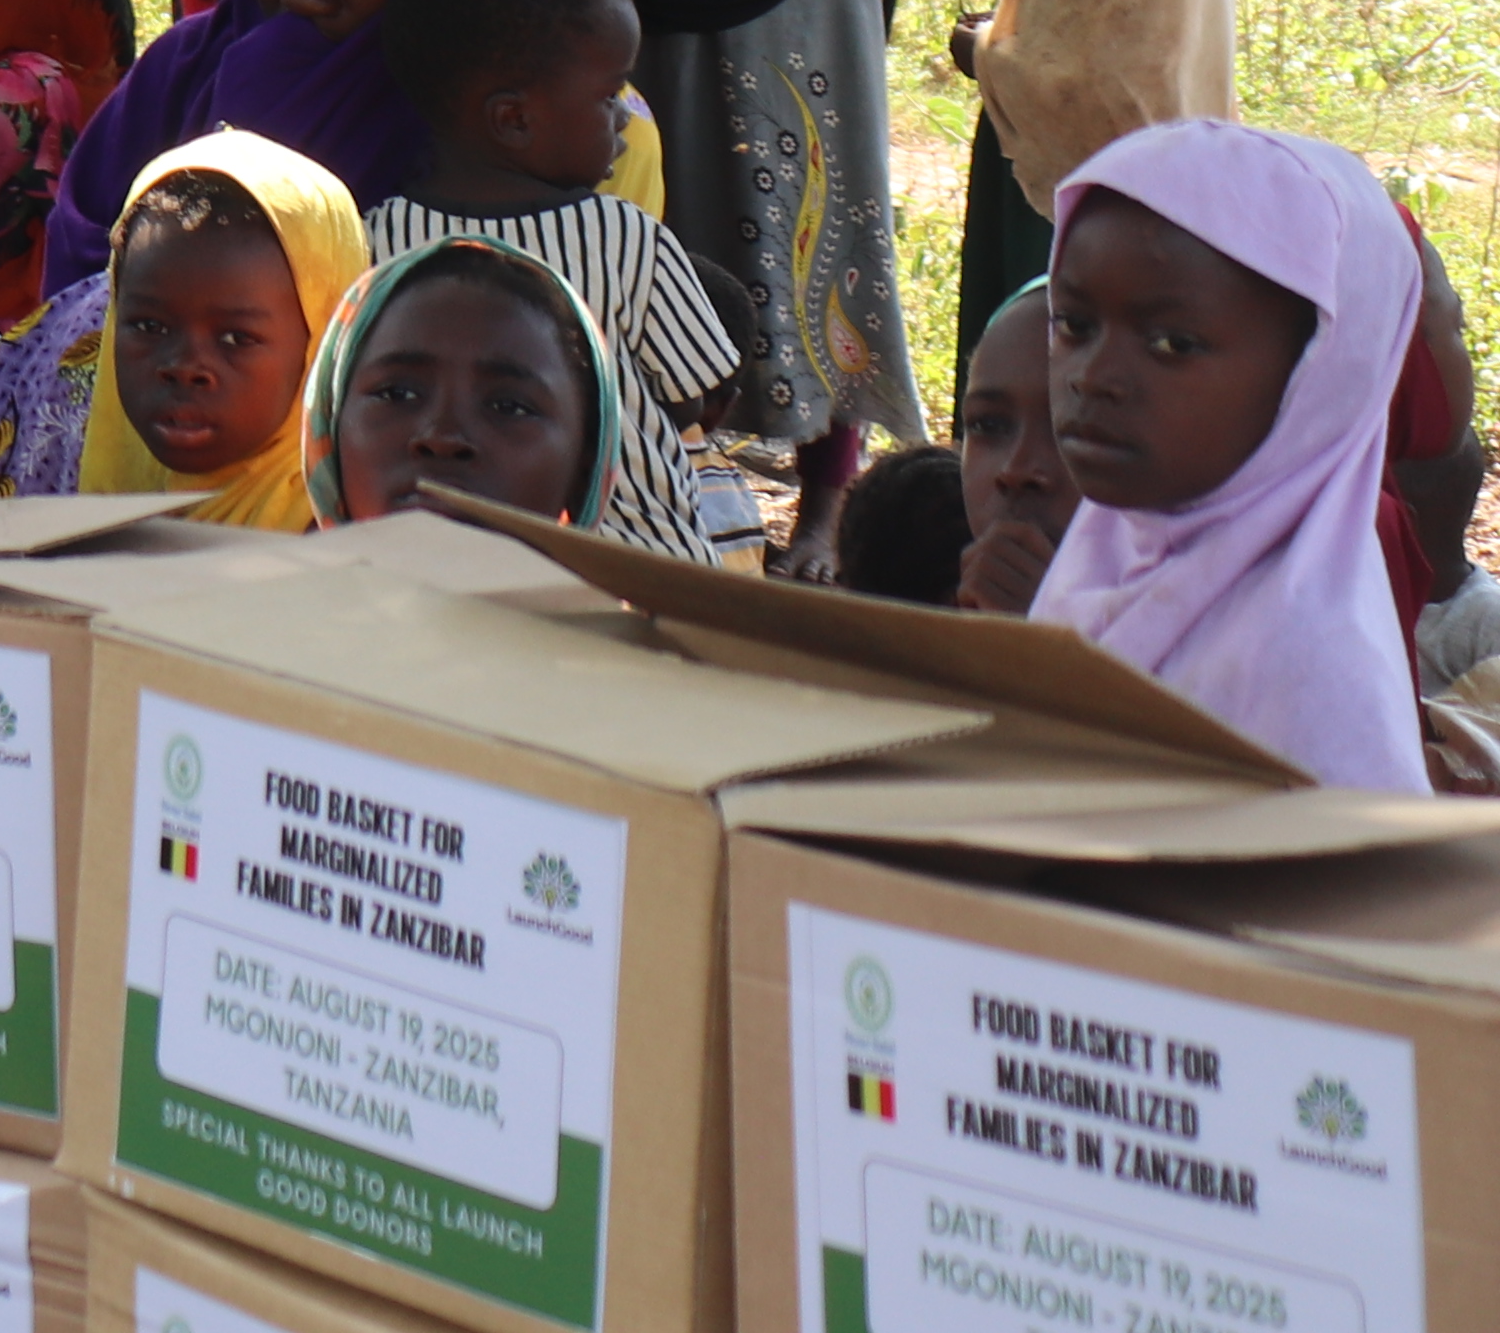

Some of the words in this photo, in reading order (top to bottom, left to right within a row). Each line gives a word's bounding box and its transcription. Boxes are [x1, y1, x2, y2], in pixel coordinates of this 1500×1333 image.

[266, 771, 321, 819] FOOD
[327, 790, 414, 847] BASKET
[421, 818, 465, 863] FOR
[279, 824, 443, 906] MARGINALIZED
[236, 859, 333, 922] FAMILIES
[339, 892, 362, 931] IN
[368, 901, 486, 970] ZANZIBAR
[972, 994, 1040, 1046] FOOD
[1049, 1012, 1156, 1075] BASKET
[1166, 1041, 1220, 1092] FOR
[995, 1053, 1199, 1141] MARGINALIZED
[946, 1095, 1066, 1163] FAMILIES
[1075, 1129, 1103, 1173] IN
[1113, 1138, 1258, 1211] ZANZIBAR
